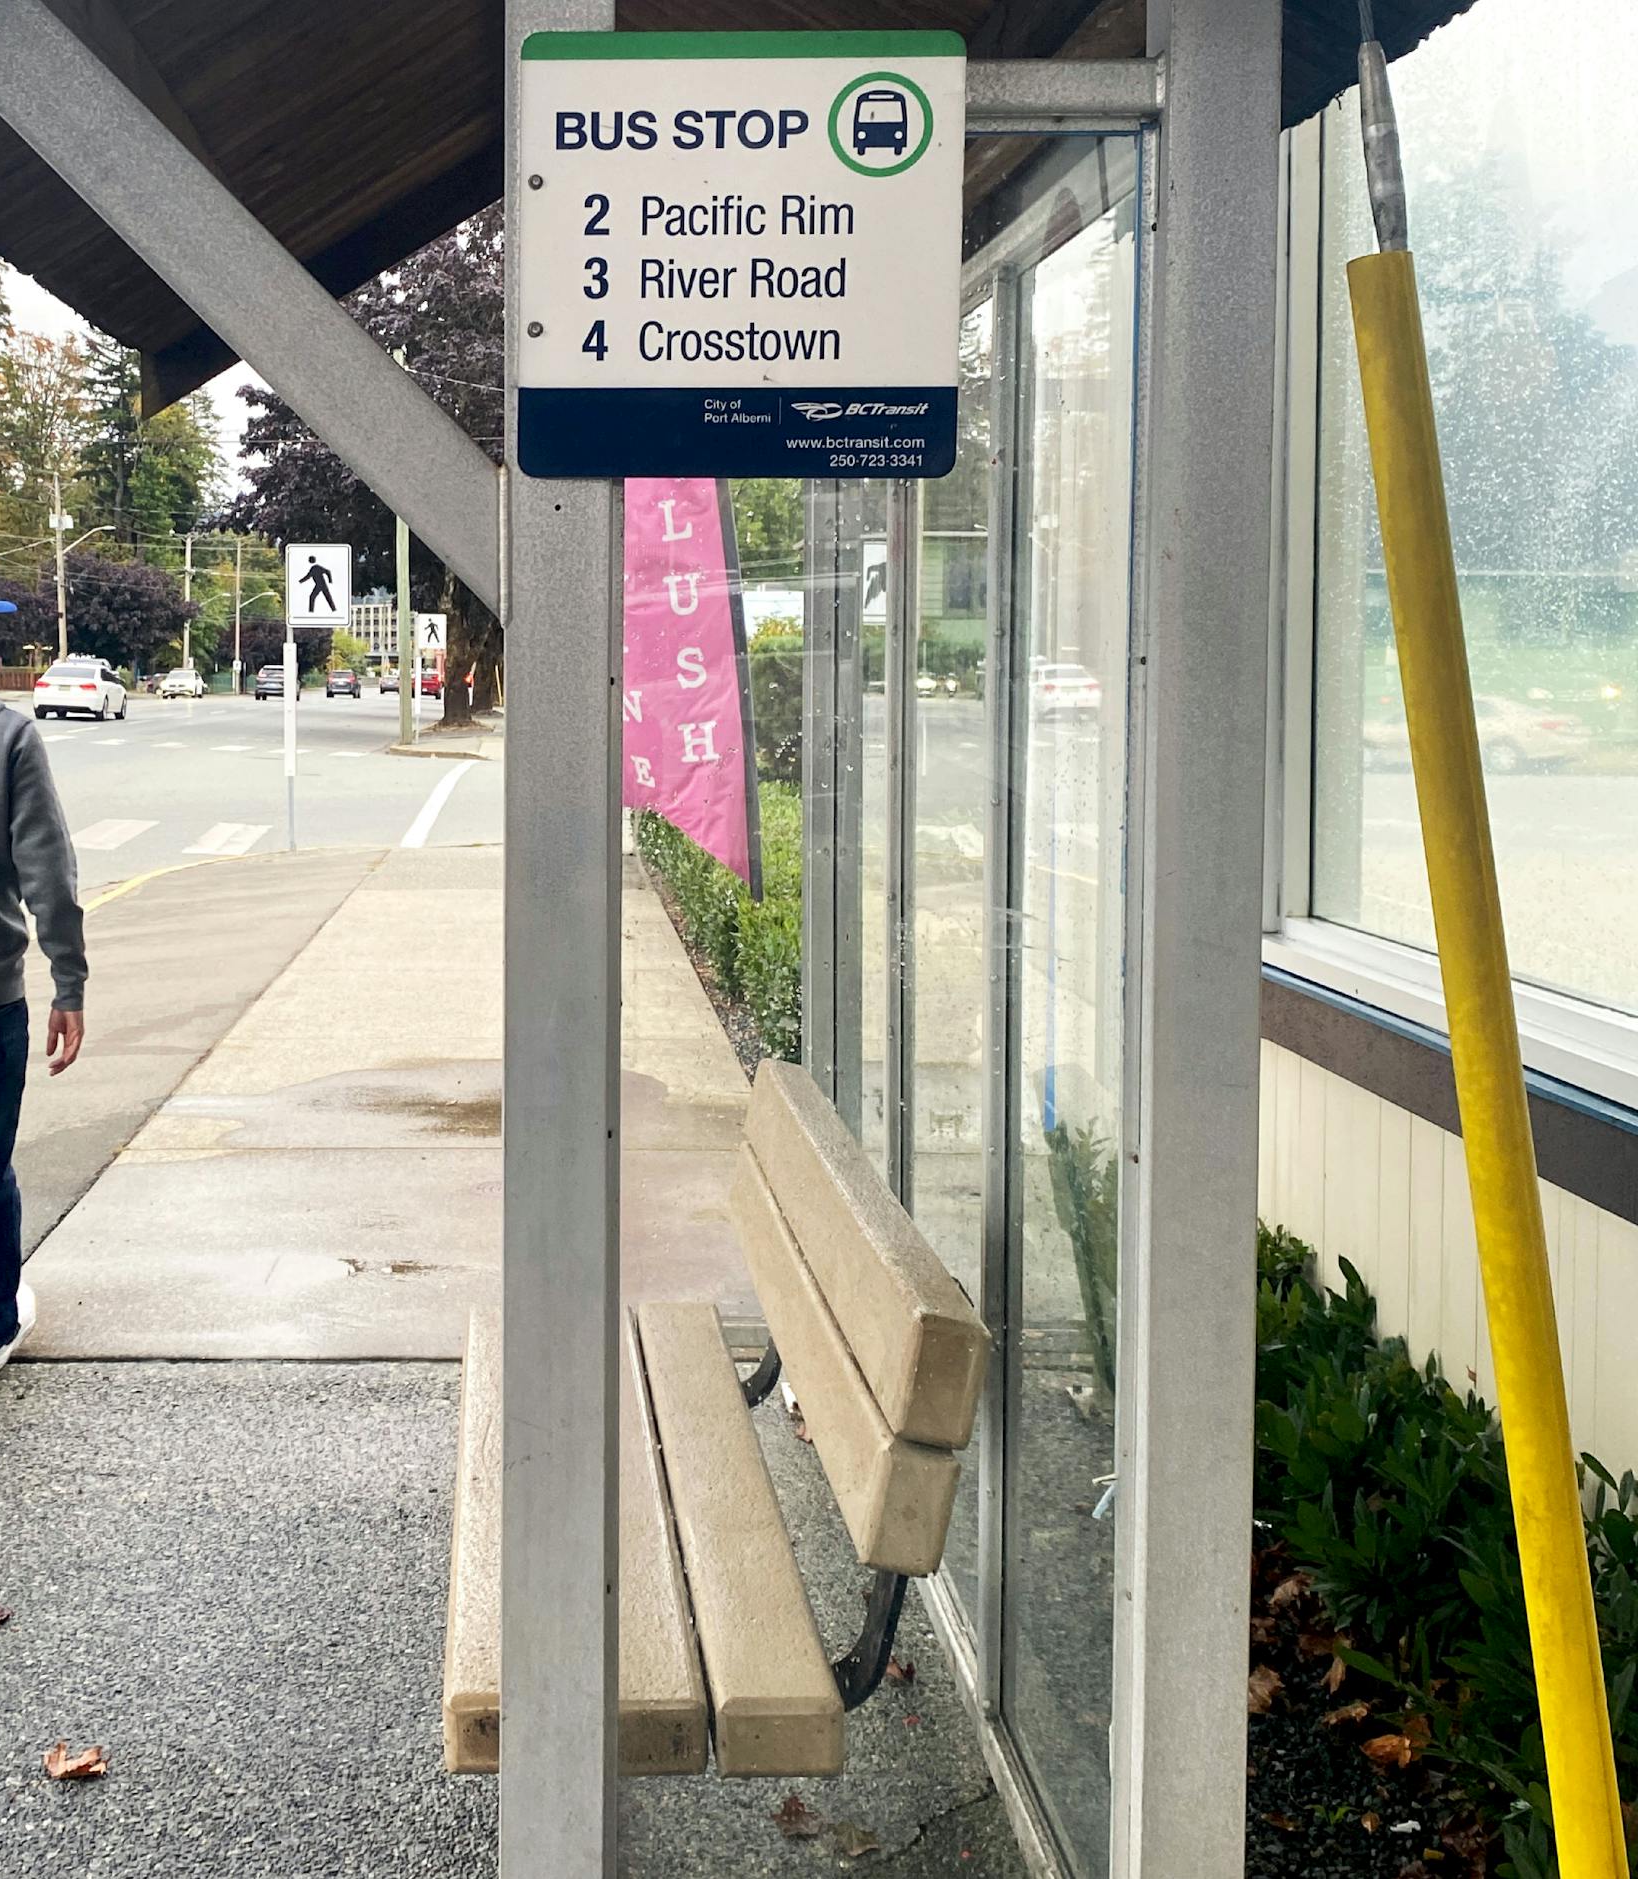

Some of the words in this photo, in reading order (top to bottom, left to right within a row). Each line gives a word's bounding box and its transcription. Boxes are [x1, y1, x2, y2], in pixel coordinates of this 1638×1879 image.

[555, 110, 658, 151] BUS
[672, 109, 809, 150] STOP
[584, 193, 610, 236] 2
[641, 195, 766, 237] Pacific
[781, 194, 854, 235] Rim
[583, 256, 609, 300] 3
[640, 258, 738, 299] River
[750, 257, 846, 299] Road
[581, 319, 609, 362] 4
[639, 320, 840, 362] Crosstown
[704, 399, 727, 412] City
[729, 399, 742, 410] of
[704, 412, 728, 424] Port
[730, 412, 771, 424] Alberni
[845, 402, 929, 416] BCTransit
[785, 436, 925, 449] www.bctransit.com
[658, 499, 720, 763] LUSH
